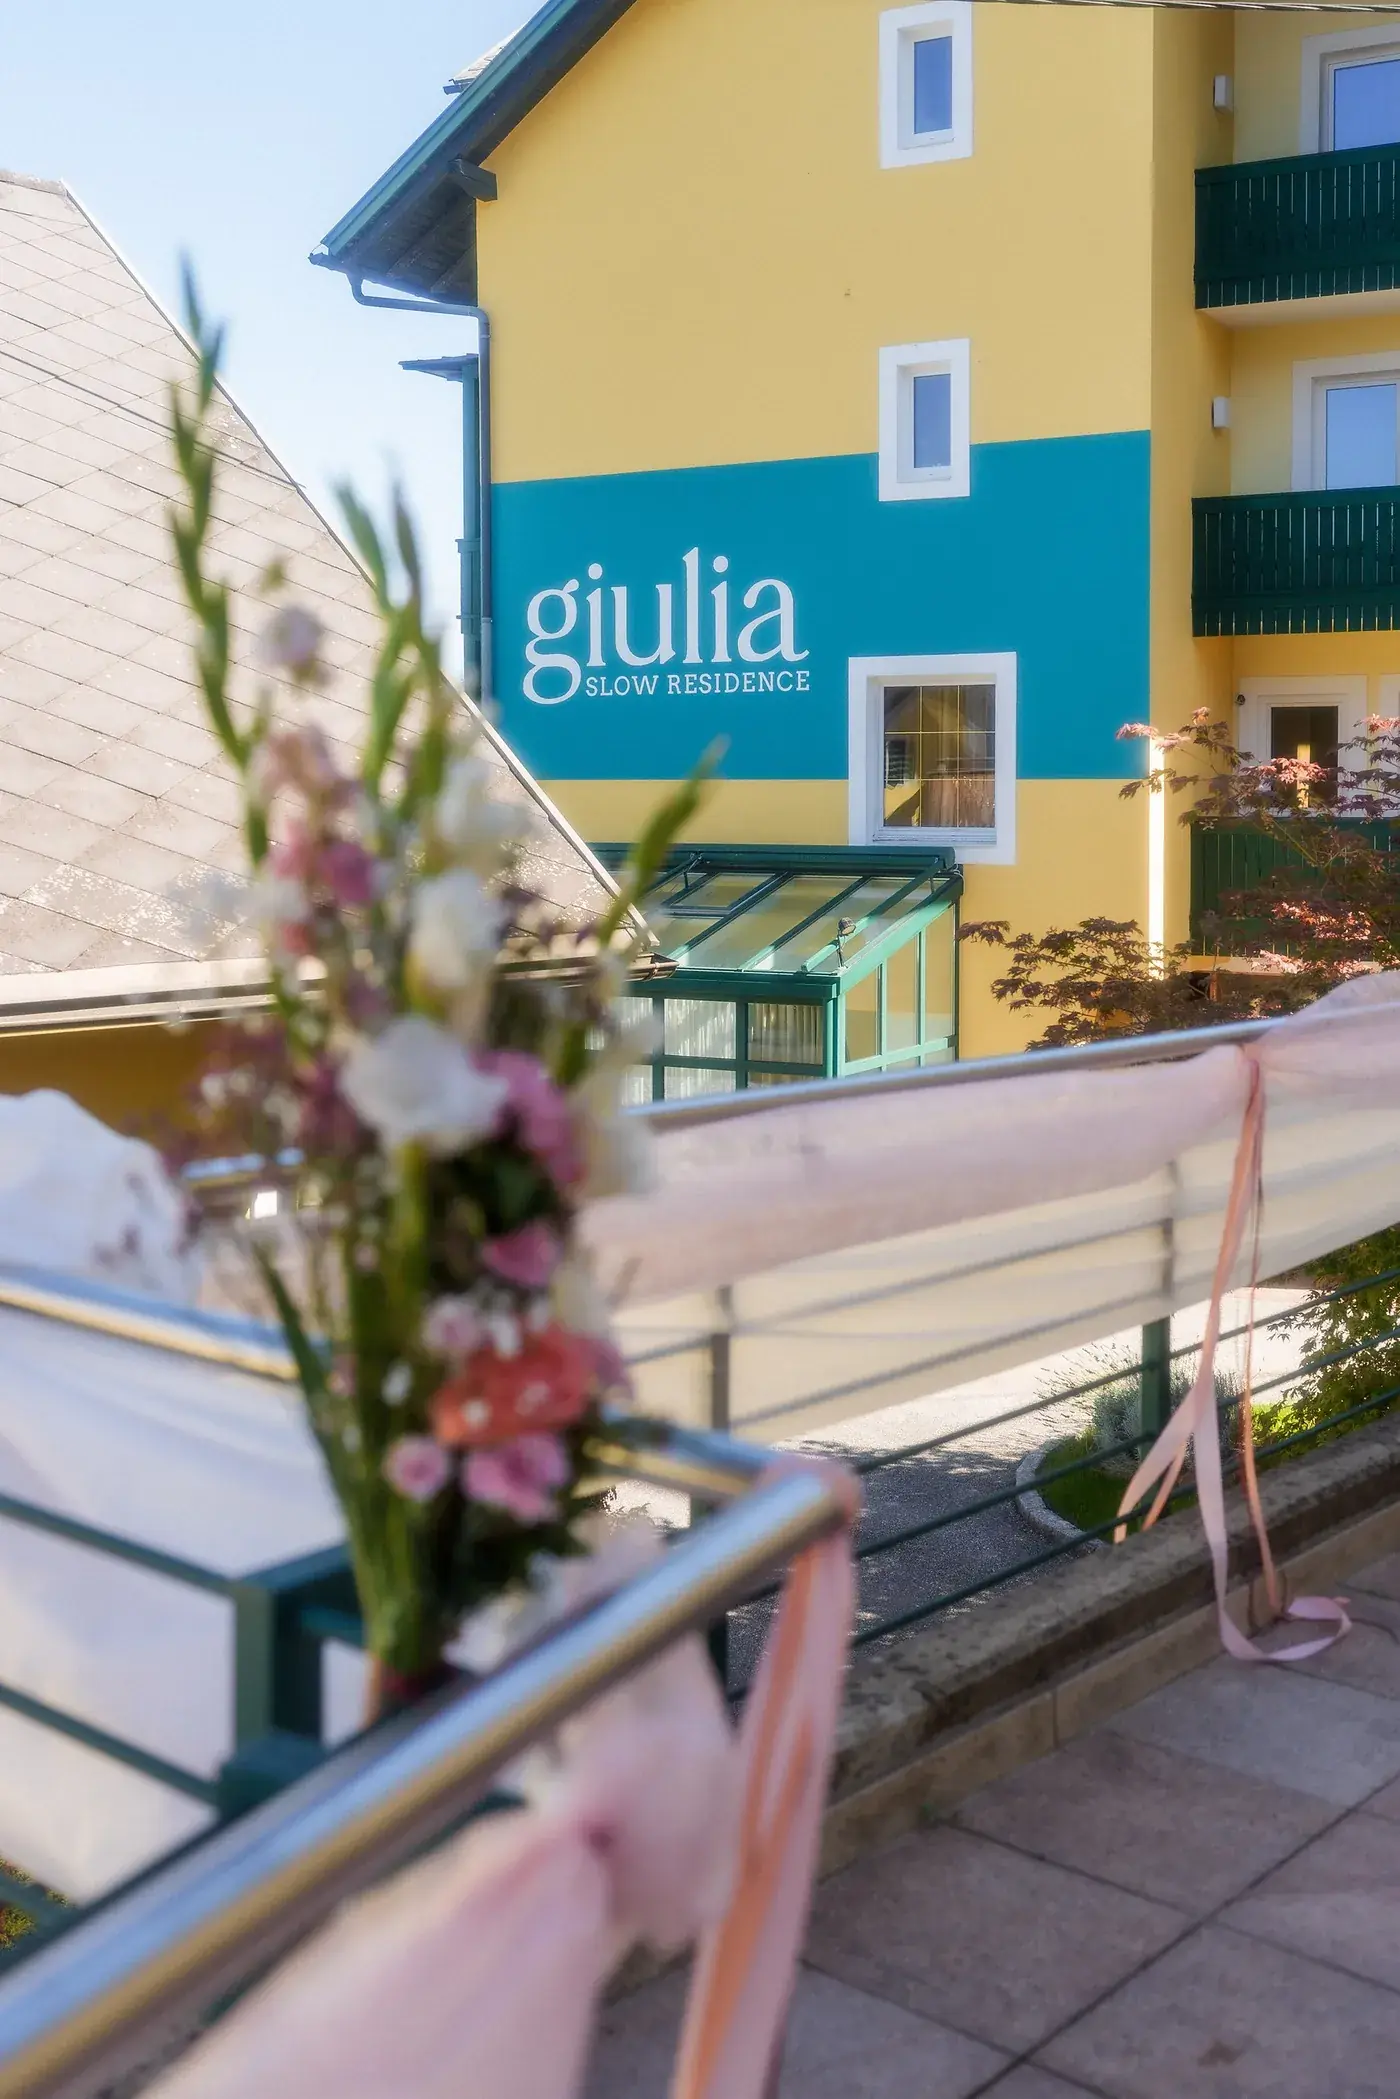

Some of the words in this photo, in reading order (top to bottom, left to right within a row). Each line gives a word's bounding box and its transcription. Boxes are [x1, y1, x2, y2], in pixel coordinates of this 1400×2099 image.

[522, 546, 810, 705] giulia
[585, 675, 659, 697] SLOW
[667, 670, 810, 694] RESIDENCE
